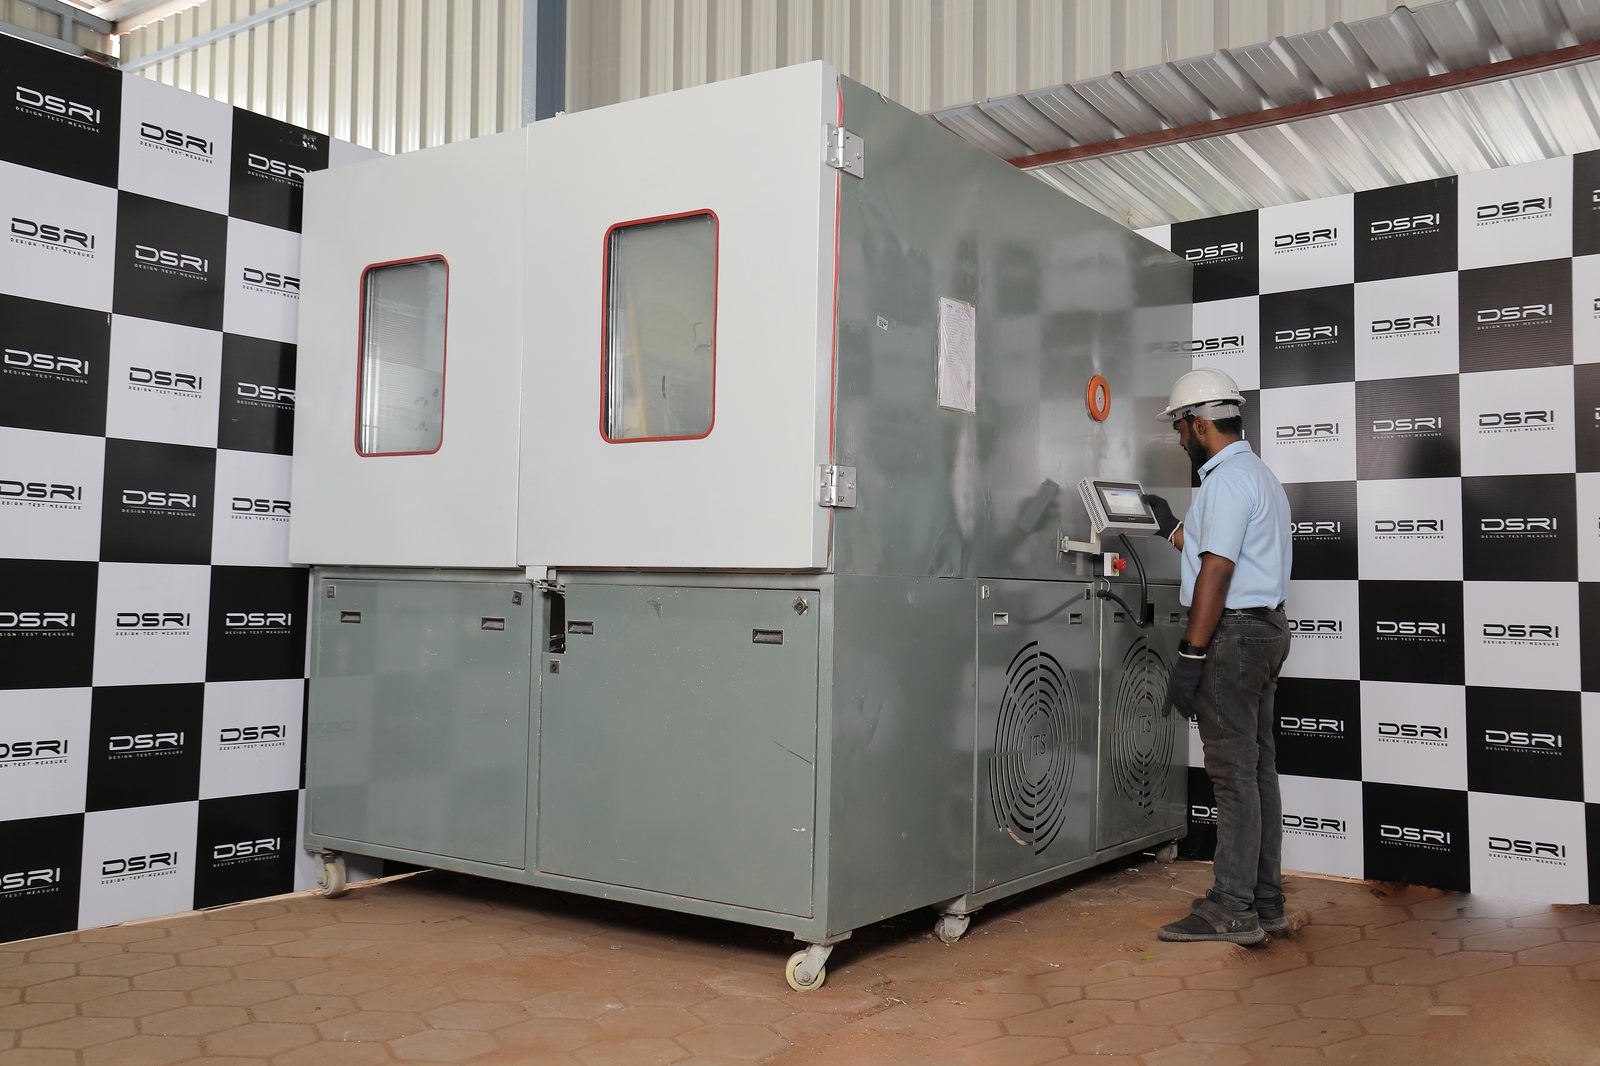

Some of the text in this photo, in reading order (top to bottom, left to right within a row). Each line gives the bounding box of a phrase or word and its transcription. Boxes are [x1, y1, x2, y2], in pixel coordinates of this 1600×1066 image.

[16, 86, 100, 124] DSRI
[141, 122, 213, 155] DSRI
[248, 153, 307, 180] DSR
[1477, 197, 1551, 219] DSRI
[1371, 213, 1439, 233] DSRI
[11, 218, 94, 249] DSRI
[1275, 228, 1337, 247] DSRI
[135, 245, 208, 272] DSRI
[1186, 242, 1243, 260] DSRI
[243, 267, 300, 290] DSR
[1477, 304, 1552, 322] DSRI
[1372, 315, 1440, 332] DSRI
[1275, 325, 1337, 342] DSRI
[4, 349, 89, 375] DSRI
[129, 367, 202, 390] DSRI
[237, 382, 295, 401] DSR
[1373, 417, 1441, 432] DSRI
[1479, 410, 1554, 426] DSRI
[1276, 423, 1339, 438] DSRI
[0, 480, 82, 500] DSRI
[123, 490, 196, 508] DSRI
[232, 497, 291, 514] DSR
[1375, 520, 1443, 532] DSRI
[1481, 518, 1557, 530] DSRI
[117, 613, 190, 627] DSRI
[226, 613, 291, 626] DSRI
[1377, 621, 1445, 635] DSRI
[1483, 624, 1558, 638] DSRI
[220, 725, 286, 742] DSRI
[1281, 717, 1344, 732] DSRI
[1378, 723, 1447, 739] DSRI
[109, 732, 184, 750] DSRI
[1485, 730, 1562, 747] DSRI
[1282, 814, 1346, 832] DSRI
[1381, 825, 1450, 844] DSRI
[214, 837, 280, 859] DSRI
[1489, 837, 1565, 858] DSRI
[102, 852, 177, 875] DSRI
[3, 868, 60, 889] SRI
